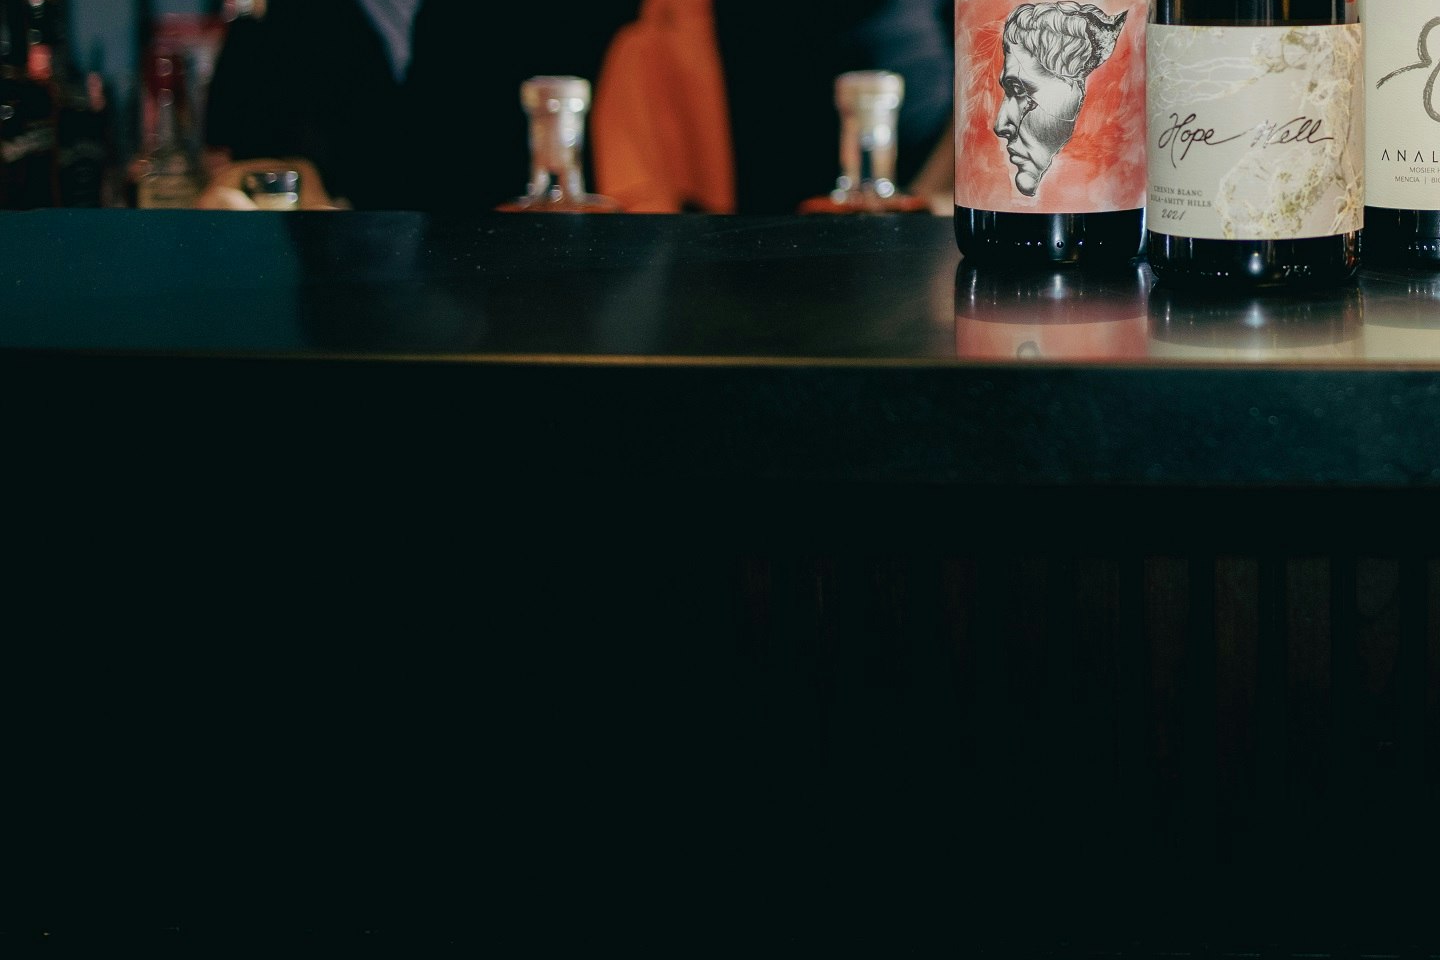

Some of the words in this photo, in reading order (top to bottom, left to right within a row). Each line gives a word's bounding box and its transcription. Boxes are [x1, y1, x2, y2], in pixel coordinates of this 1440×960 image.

[1158, 112, 1253, 168] Hope
[1409, 166, 1436, 175] MOSIER
[1177, 188, 1203, 197] BLANC
[1187, 199, 1212, 208] HILLS
[1161, 208, 1186, 220] 2021
